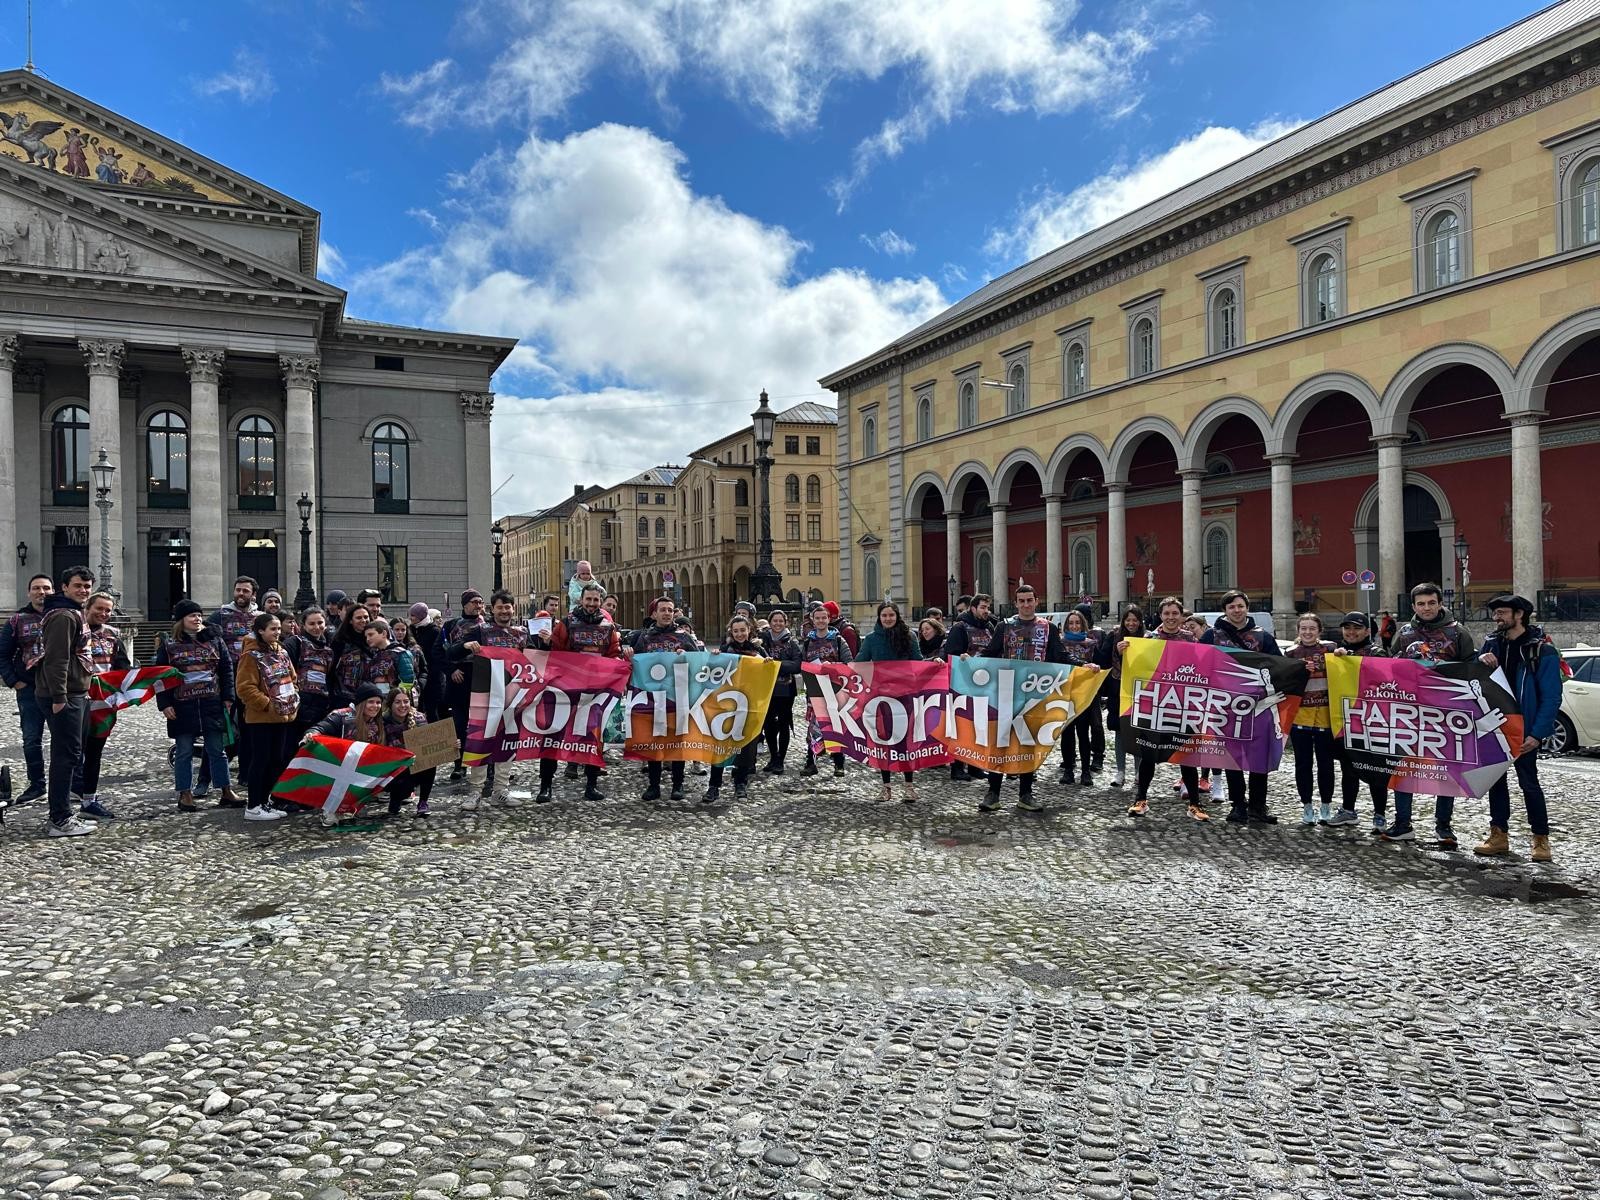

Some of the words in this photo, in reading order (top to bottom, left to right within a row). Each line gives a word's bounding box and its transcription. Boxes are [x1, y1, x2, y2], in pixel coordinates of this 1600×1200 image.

[1031, 627, 1045, 662] orrika
[511, 662, 544, 684] 23.
[694, 659, 740, 687] aek
[1177, 663, 1196, 674] aek
[838, 674, 871, 694] 23.
[1021, 672, 1071, 697] aek
[1379, 679, 1398, 691] aek
[1134, 680, 1256, 716] HARRO
[815, 669, 1077, 748] korrika
[1343, 698, 1474, 735] HARRO
[501, 736, 541, 751] Irundik
[543, 738, 598, 755] Baionara
[853, 740, 887, 760] Irundik
[1172, 735, 1195, 745] Irundik
[954, 746, 986, 762] 2024ko
[1409, 761, 1448, 772] Baionarat
[1409, 770, 1428, 779] 14tik
[1429, 772, 1448, 781] 24ra
